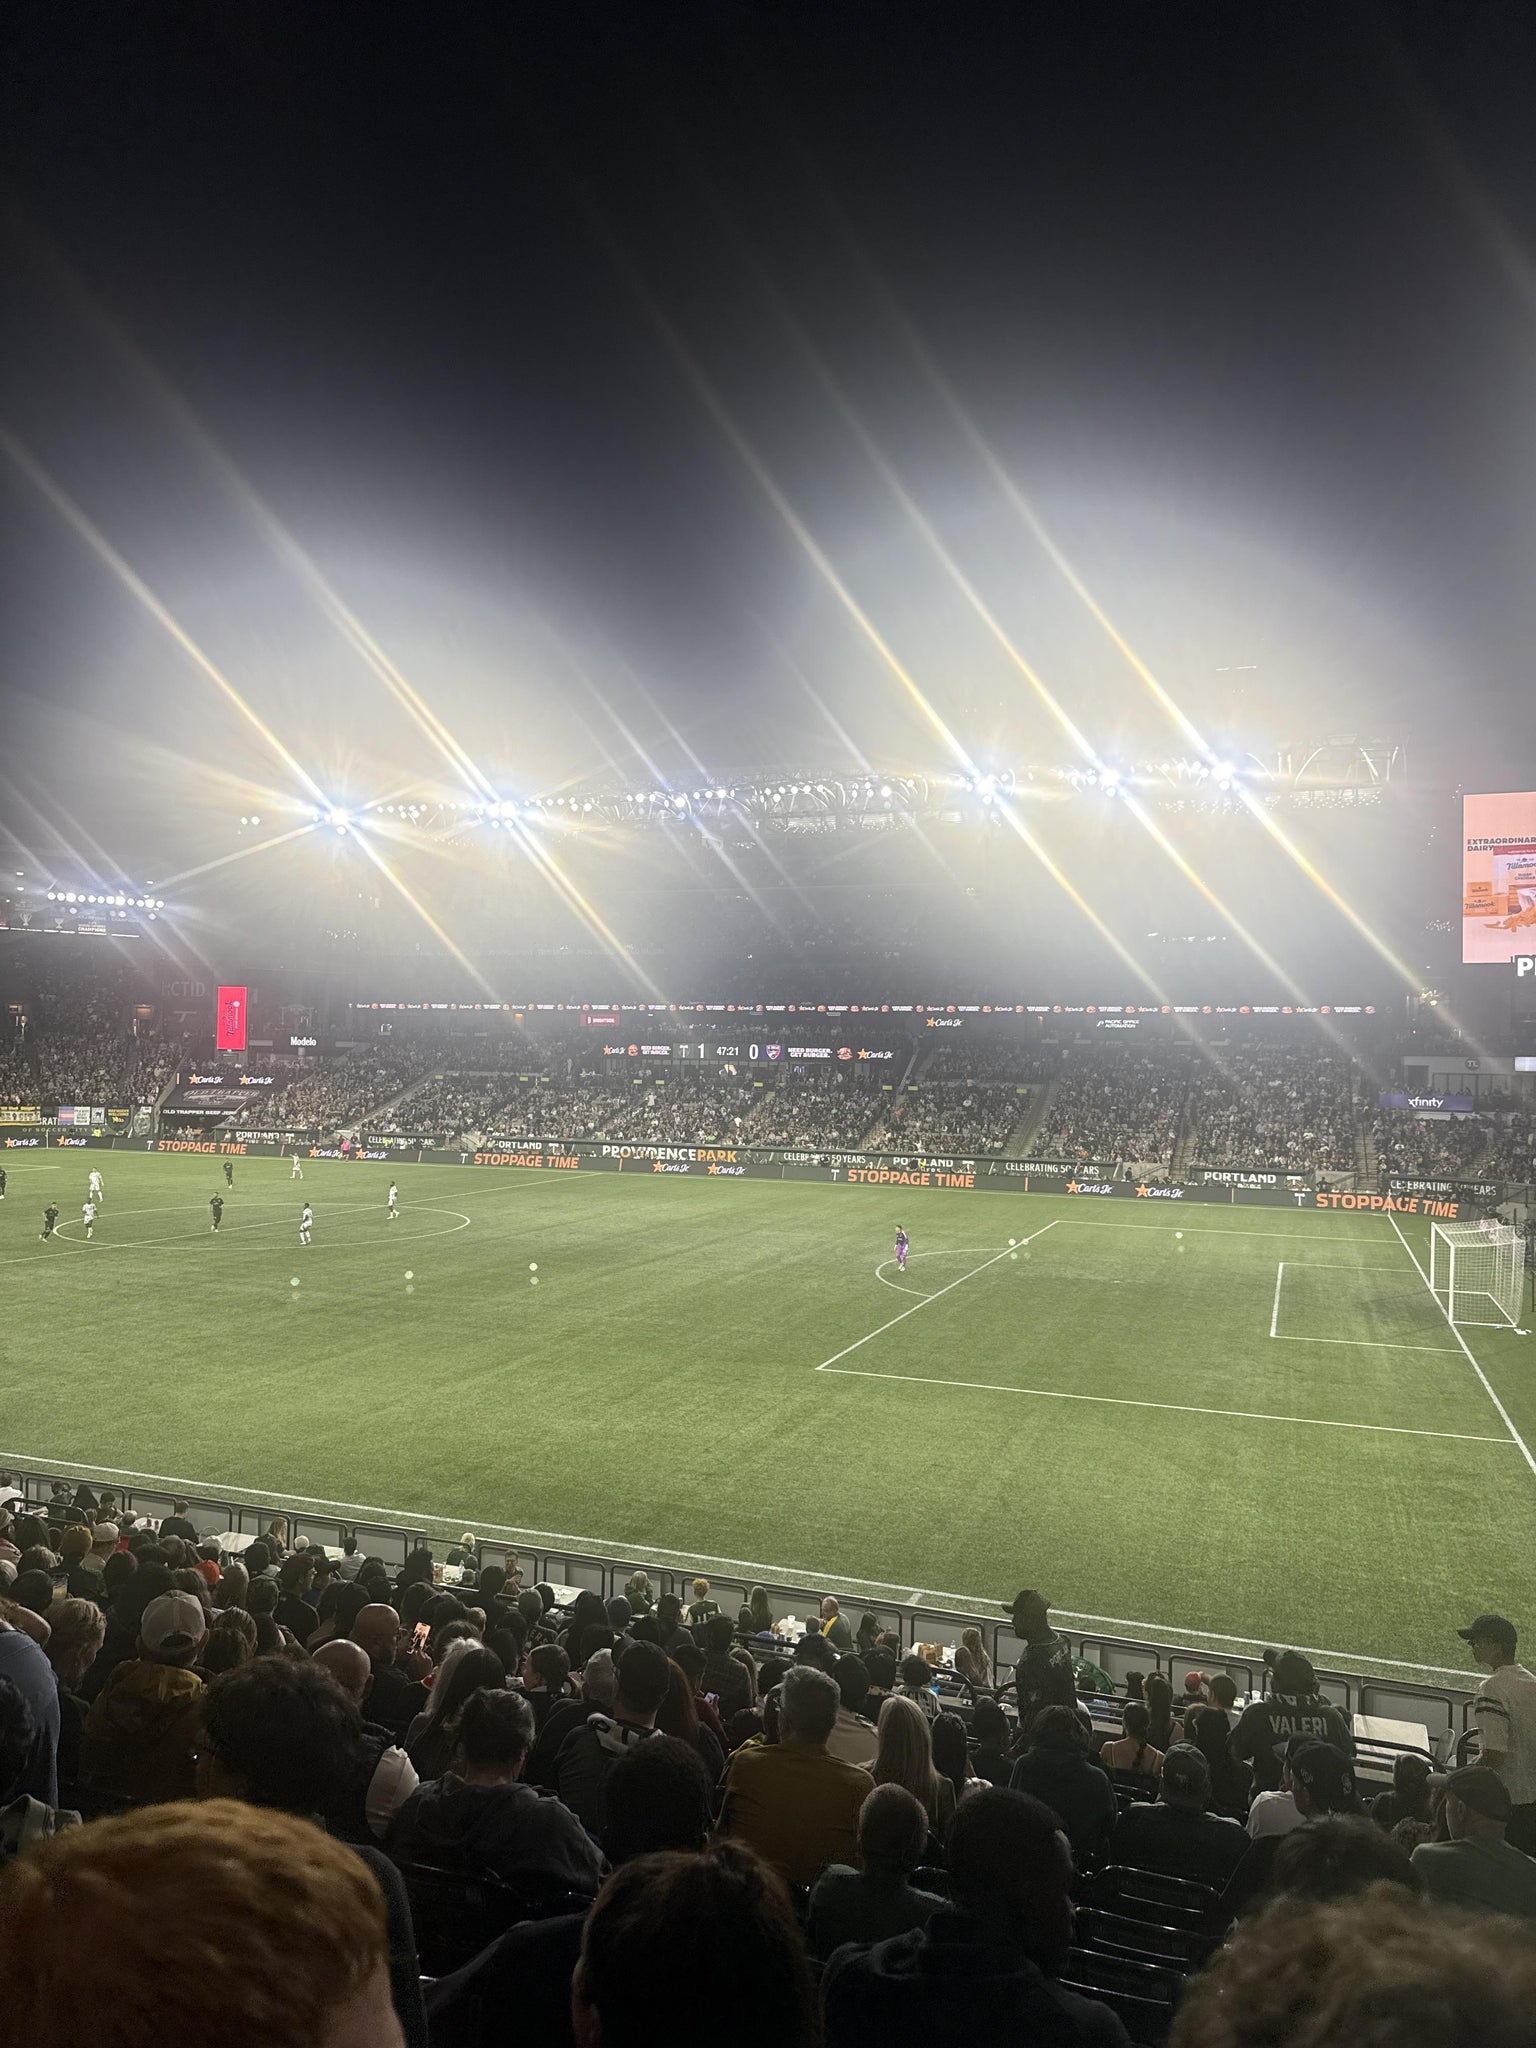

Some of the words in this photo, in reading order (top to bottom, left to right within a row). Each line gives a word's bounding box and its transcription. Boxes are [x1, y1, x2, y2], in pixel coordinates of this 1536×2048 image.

[290, 1036, 317, 1046] Modelo
[698, 1043, 705, 1059] 1
[716, 1046, 739, 1056] 47:21
[749, 1043, 759, 1060] 0
[1407, 1096, 1444, 1108] xfinity
[158, 1140, 216, 1153] STOPPAGE
[220, 1142, 248, 1154] TIME
[495, 1140, 542, 1150] ORTLAND
[474, 1153, 543, 1167] STOPPAGE
[547, 1155, 579, 1169] TIME
[842, 1155, 866, 1163] YEARS
[1005, 1162, 1058, 1173] CELEBRATING
[847, 1169, 931, 1186] STOPPAGE
[935, 1173, 975, 1188] TIME
[1204, 1171, 1277, 1184] PORTLAND
[1316, 1193, 1419, 1213] STOPPAGE
[1422, 1199, 1459, 1218] TIME
[1269, 1714, 1328, 1736] VALERI
